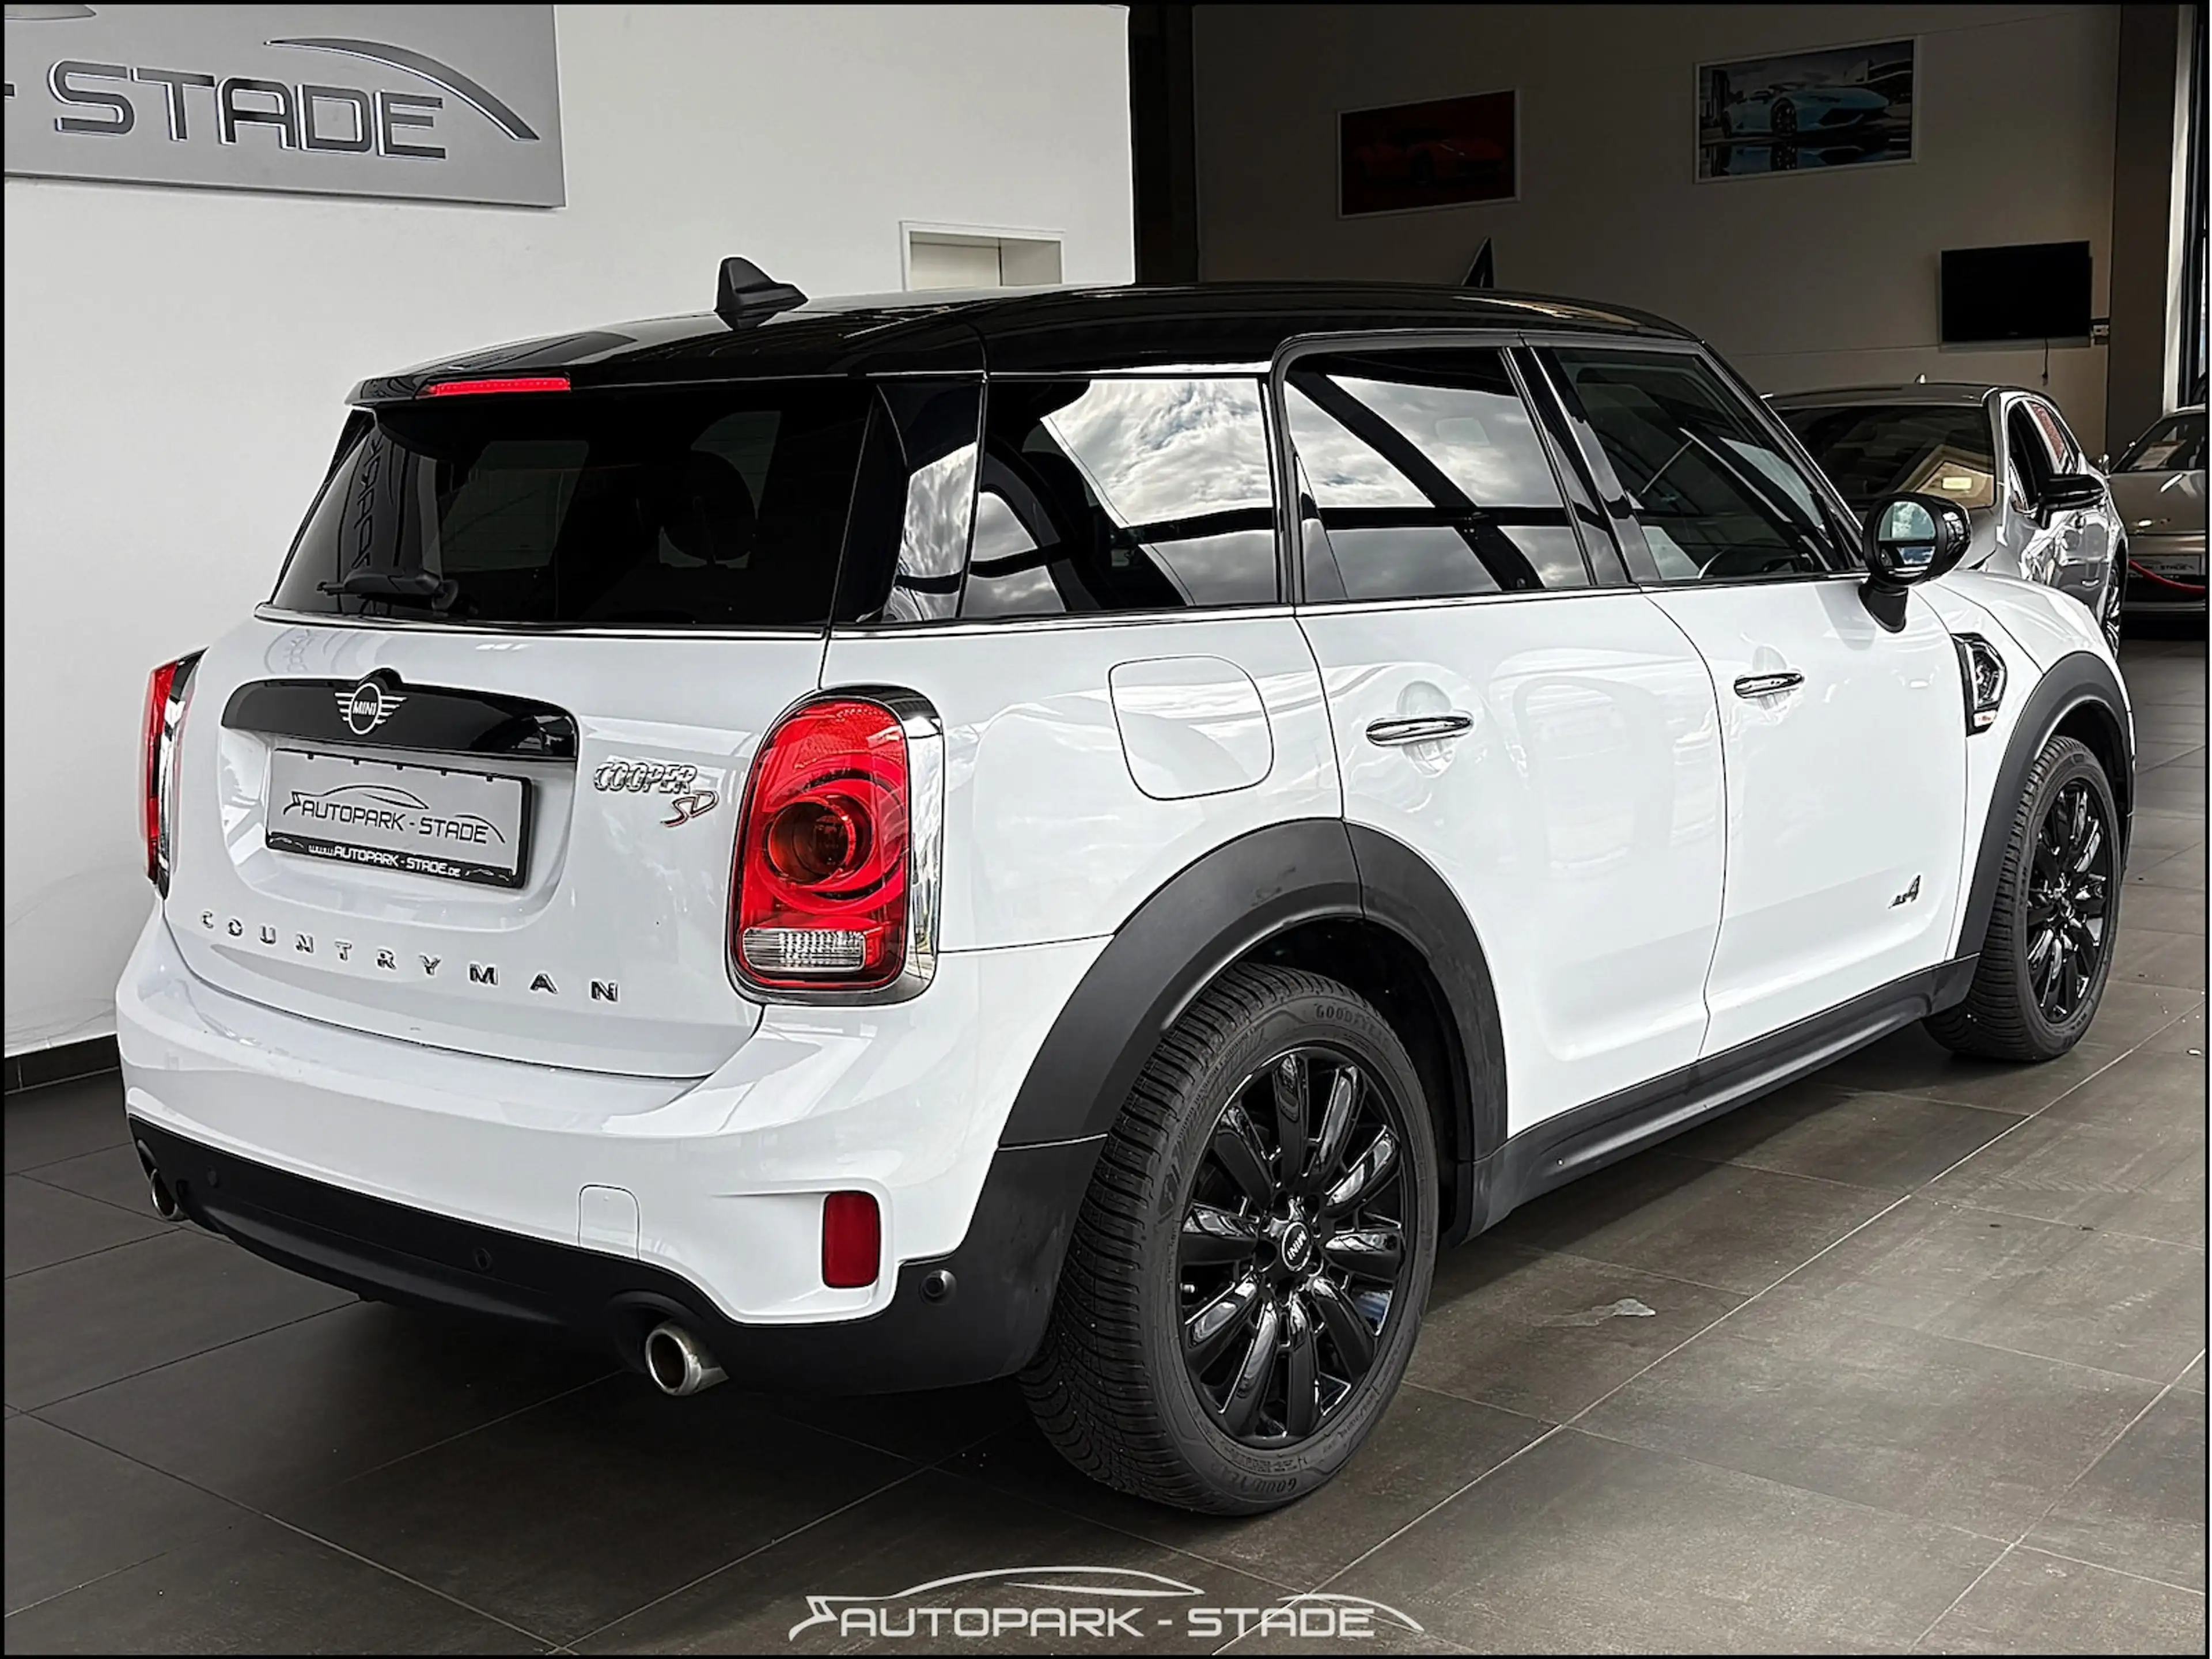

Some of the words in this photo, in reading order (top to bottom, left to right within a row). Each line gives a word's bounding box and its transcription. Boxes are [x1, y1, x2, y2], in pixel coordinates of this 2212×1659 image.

[48, 60, 446, 159] STADE
[353, 700, 377, 715] MINI
[593, 762, 698, 794] COOPER
[301, 800, 405, 831] AUTOPARK
[418, 817, 488, 844] STADE
[660, 789, 719, 828] SD
[201, 910, 619, 1002] COUNTRYMAN
[1286, 1229, 1308, 1260] MINI
